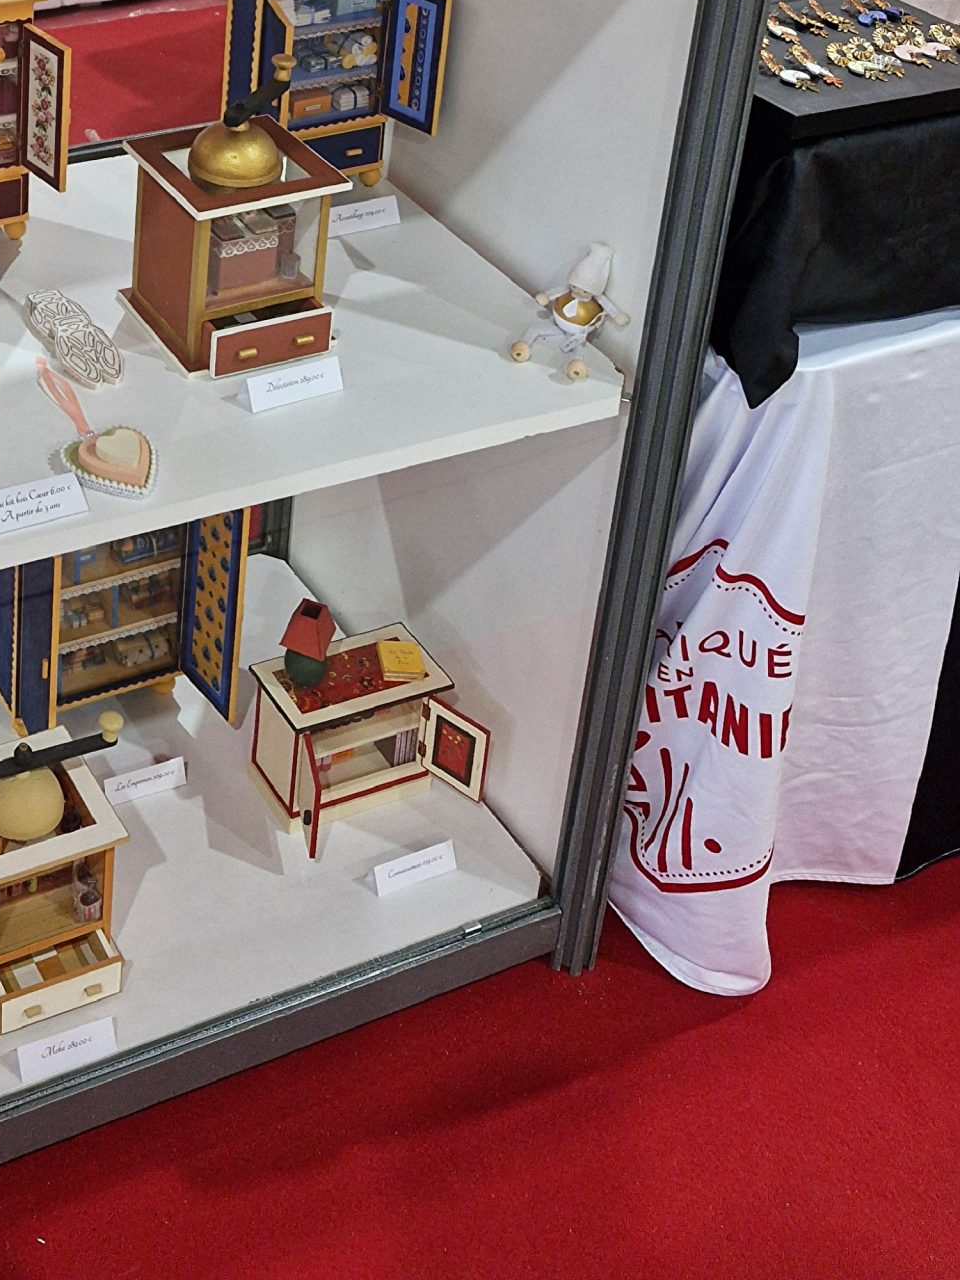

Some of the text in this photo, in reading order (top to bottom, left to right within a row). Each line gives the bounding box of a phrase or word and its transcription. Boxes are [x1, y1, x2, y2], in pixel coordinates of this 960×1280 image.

[15, 509, 34, 522] partir
[35, 500, 43, 514] de
[657, 660, 694, 683] EN
